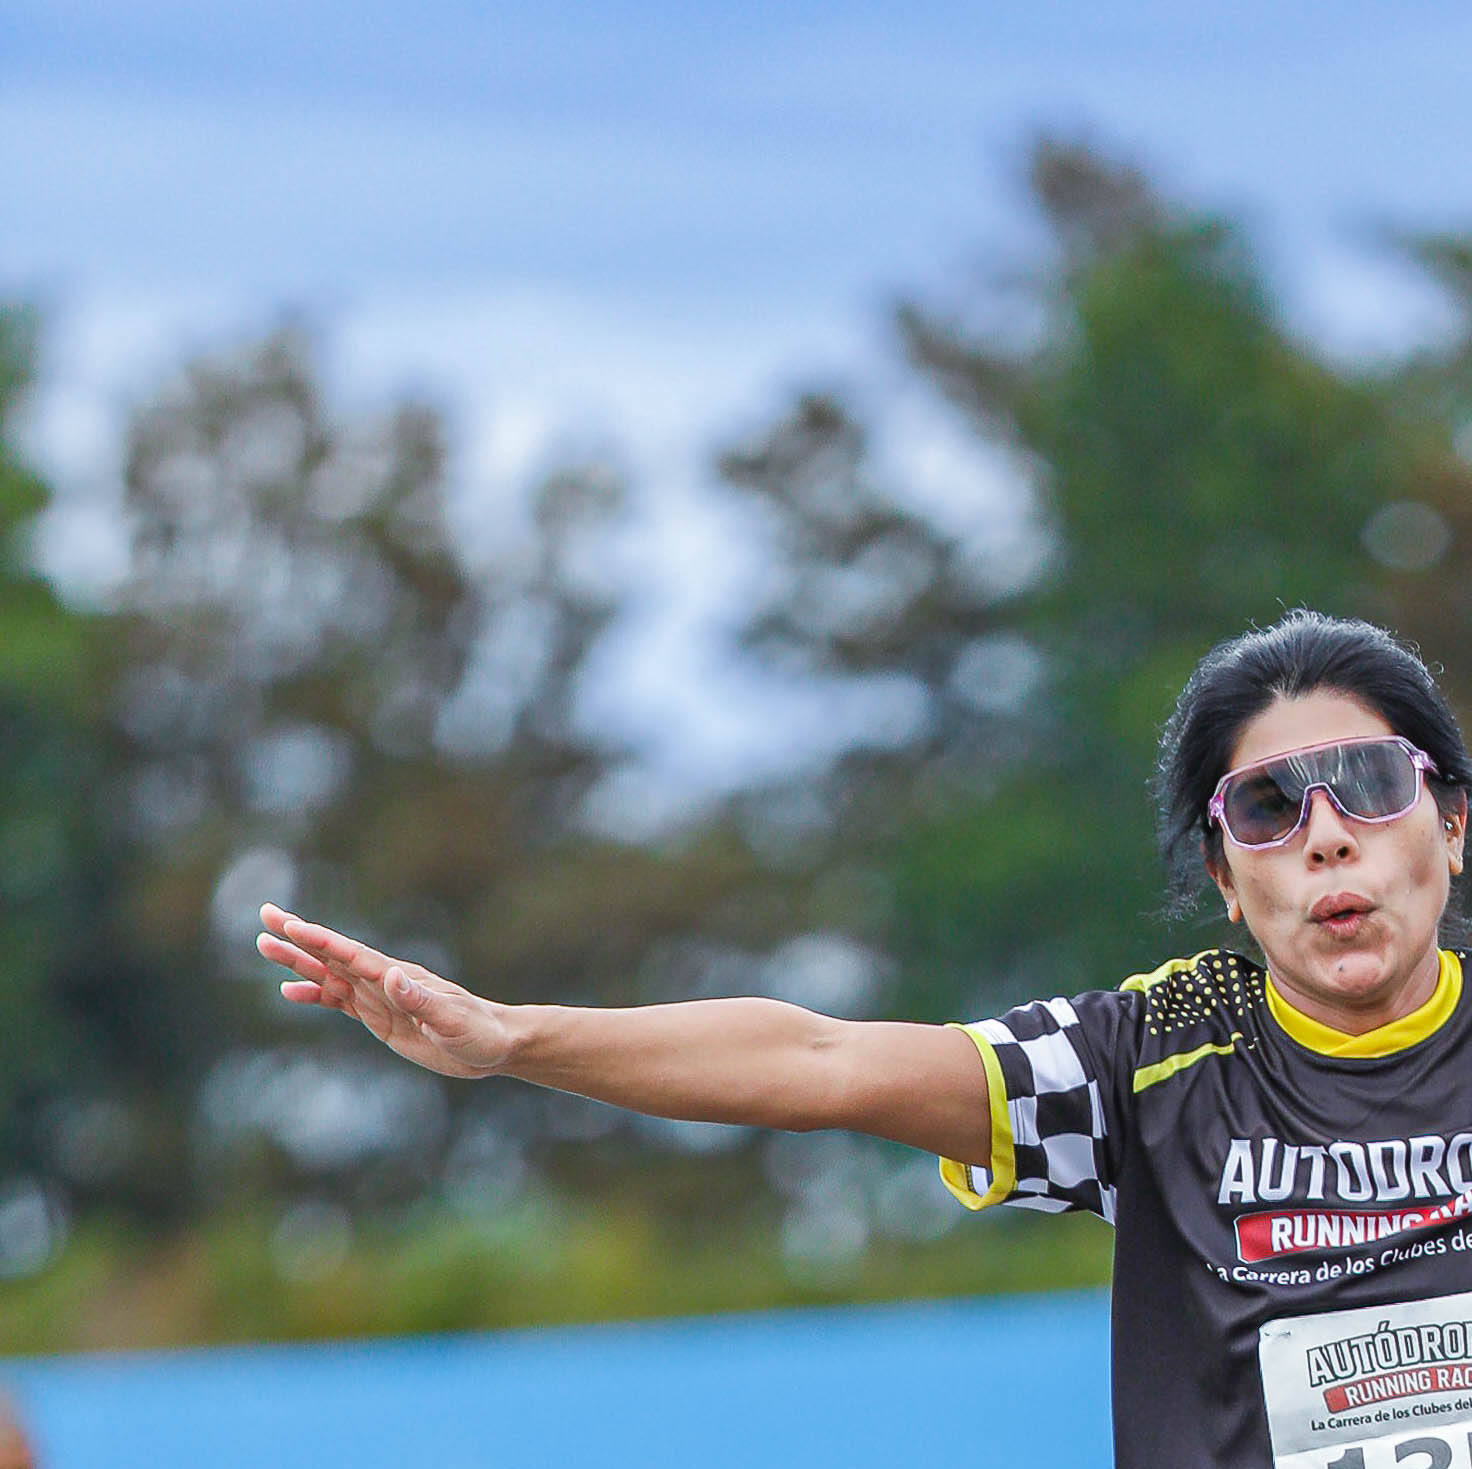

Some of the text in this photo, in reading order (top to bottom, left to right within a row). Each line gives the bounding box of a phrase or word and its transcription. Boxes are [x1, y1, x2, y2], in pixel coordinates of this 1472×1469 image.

[1232, 1266, 1311, 1285] Carrera
[1316, 1261, 1342, 1282] de
[1346, 1256, 1375, 1275] los
[1343, 1369, 1432, 1408] RUNNING
[1311, 1419, 1325, 1432] La
[1328, 1415, 1372, 1430] Carrera
[1375, 1410, 1390, 1423] de
[1392, 1407, 1410, 1420] los
[1412, 1401, 1452, 1417] Clubes
